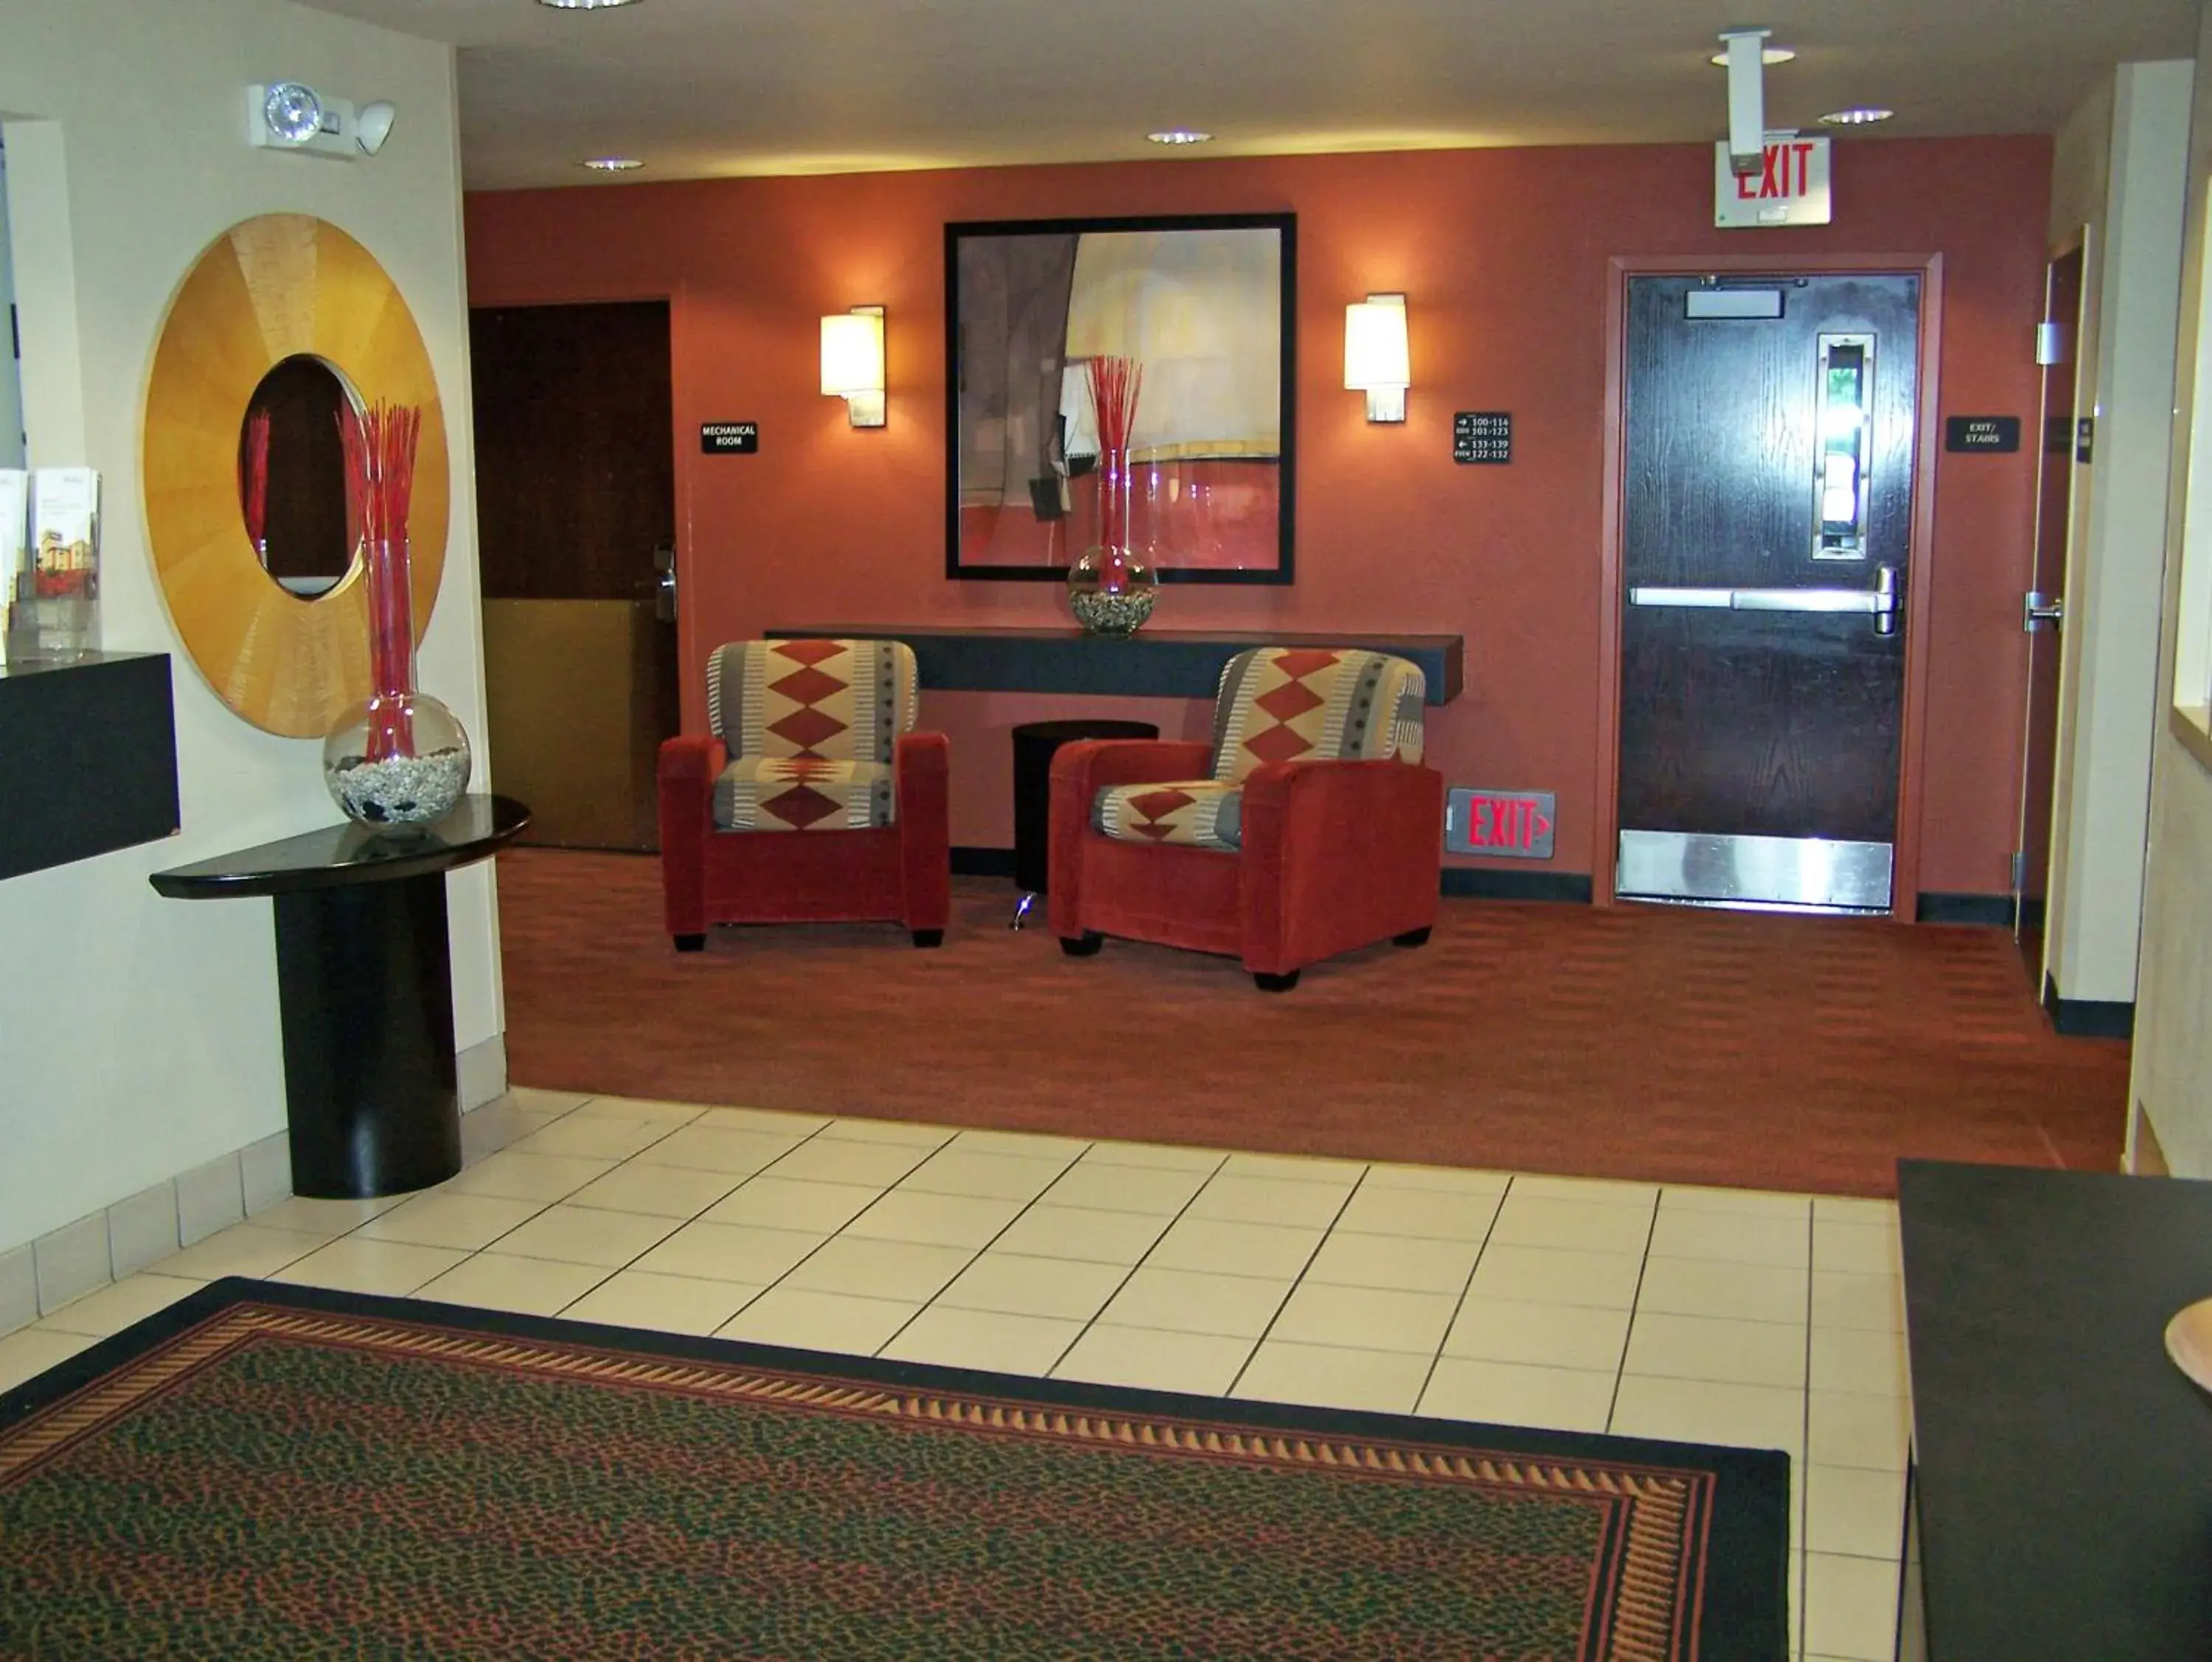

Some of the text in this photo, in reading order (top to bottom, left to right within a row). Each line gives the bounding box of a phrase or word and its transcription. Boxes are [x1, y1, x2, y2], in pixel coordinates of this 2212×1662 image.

[703, 425, 756, 436] MECHANICAL
[716, 437, 742, 446] ROOM
[1965, 434, 2000, 443] STAIRS
[1470, 796, 1537, 850] EXIT
